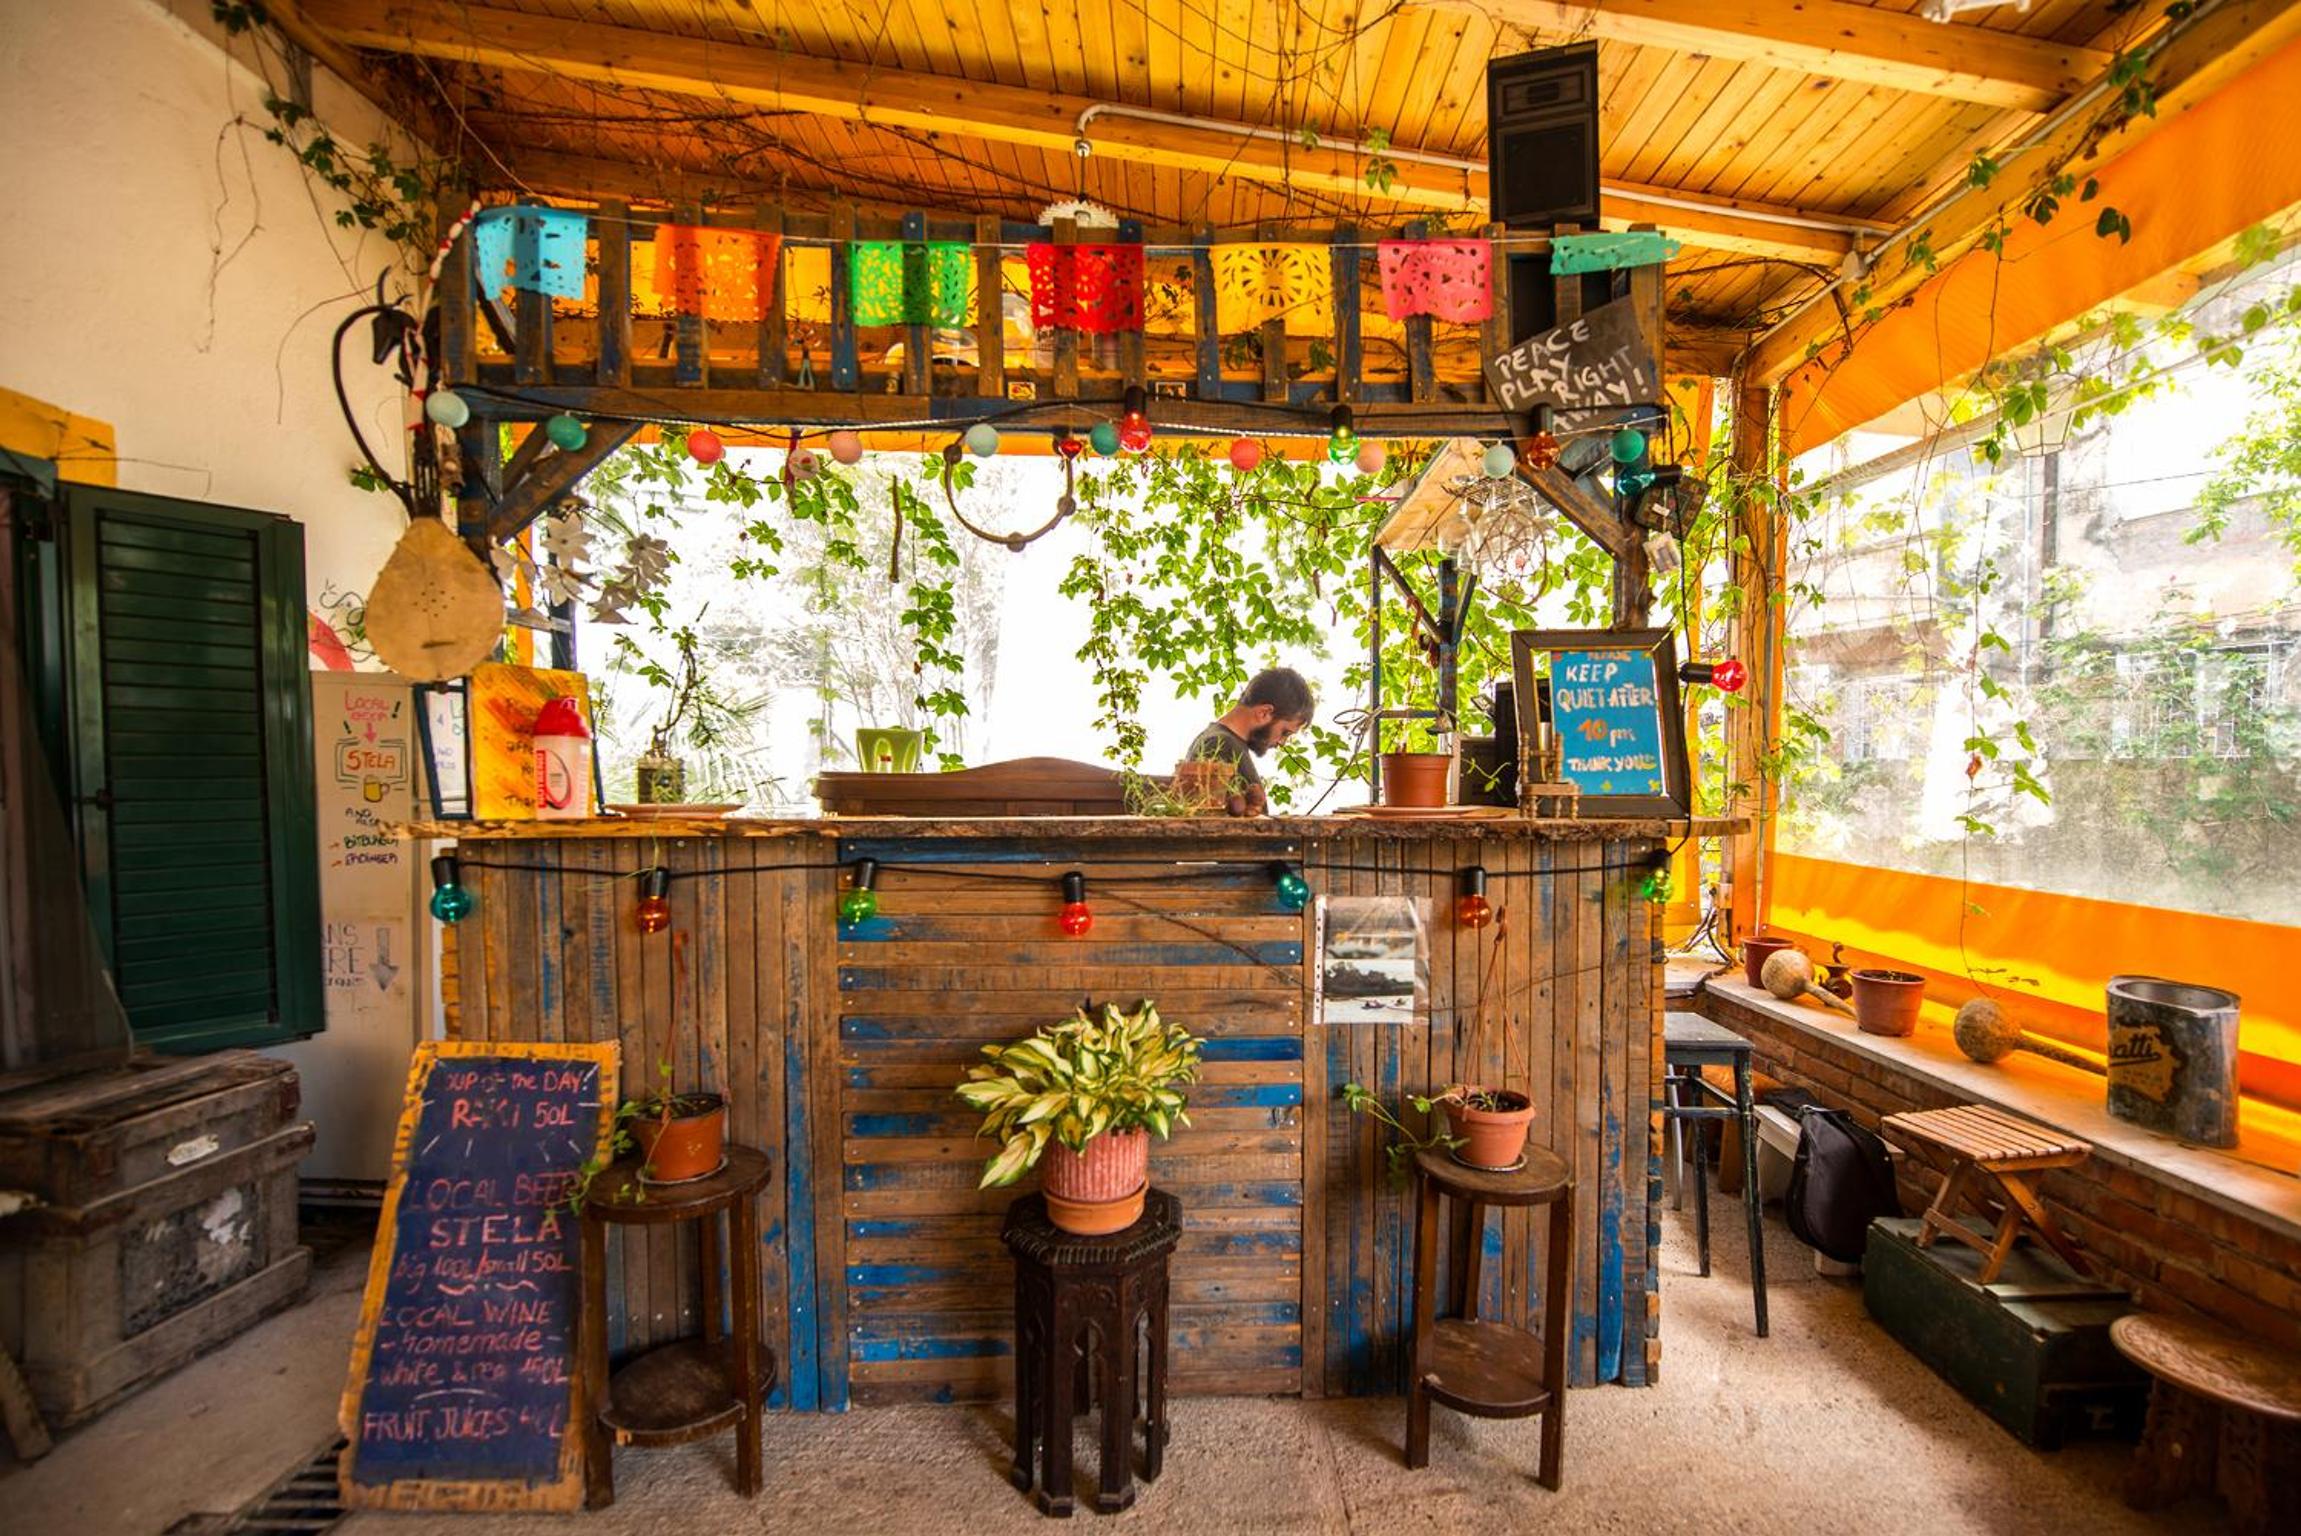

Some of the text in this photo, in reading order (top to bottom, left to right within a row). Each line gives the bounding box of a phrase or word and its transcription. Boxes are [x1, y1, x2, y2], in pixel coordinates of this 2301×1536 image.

[1495, 319, 1590, 379] PEACE
[1501, 352, 1571, 410] PLAY
[1551, 345, 1632, 404] RIGHT
[1566, 662, 1618, 683] KEEP
[1556, 687, 1605, 712] QUIET
[1577, 719, 1608, 742] 10
[346, 750, 396, 770] STELA
[1567, 757, 1613, 772] THANK
[322, 922, 359, 946] NS
[2111, 1033, 2153, 1060] atti
[410, 1177, 507, 1212] LOCAL
[429, 1214, 563, 1248] STELA
[379, 1299, 552, 1328] LOCAL WINE
[402, 1329, 544, 1355] homemade
[380, 1360, 444, 1387] white
